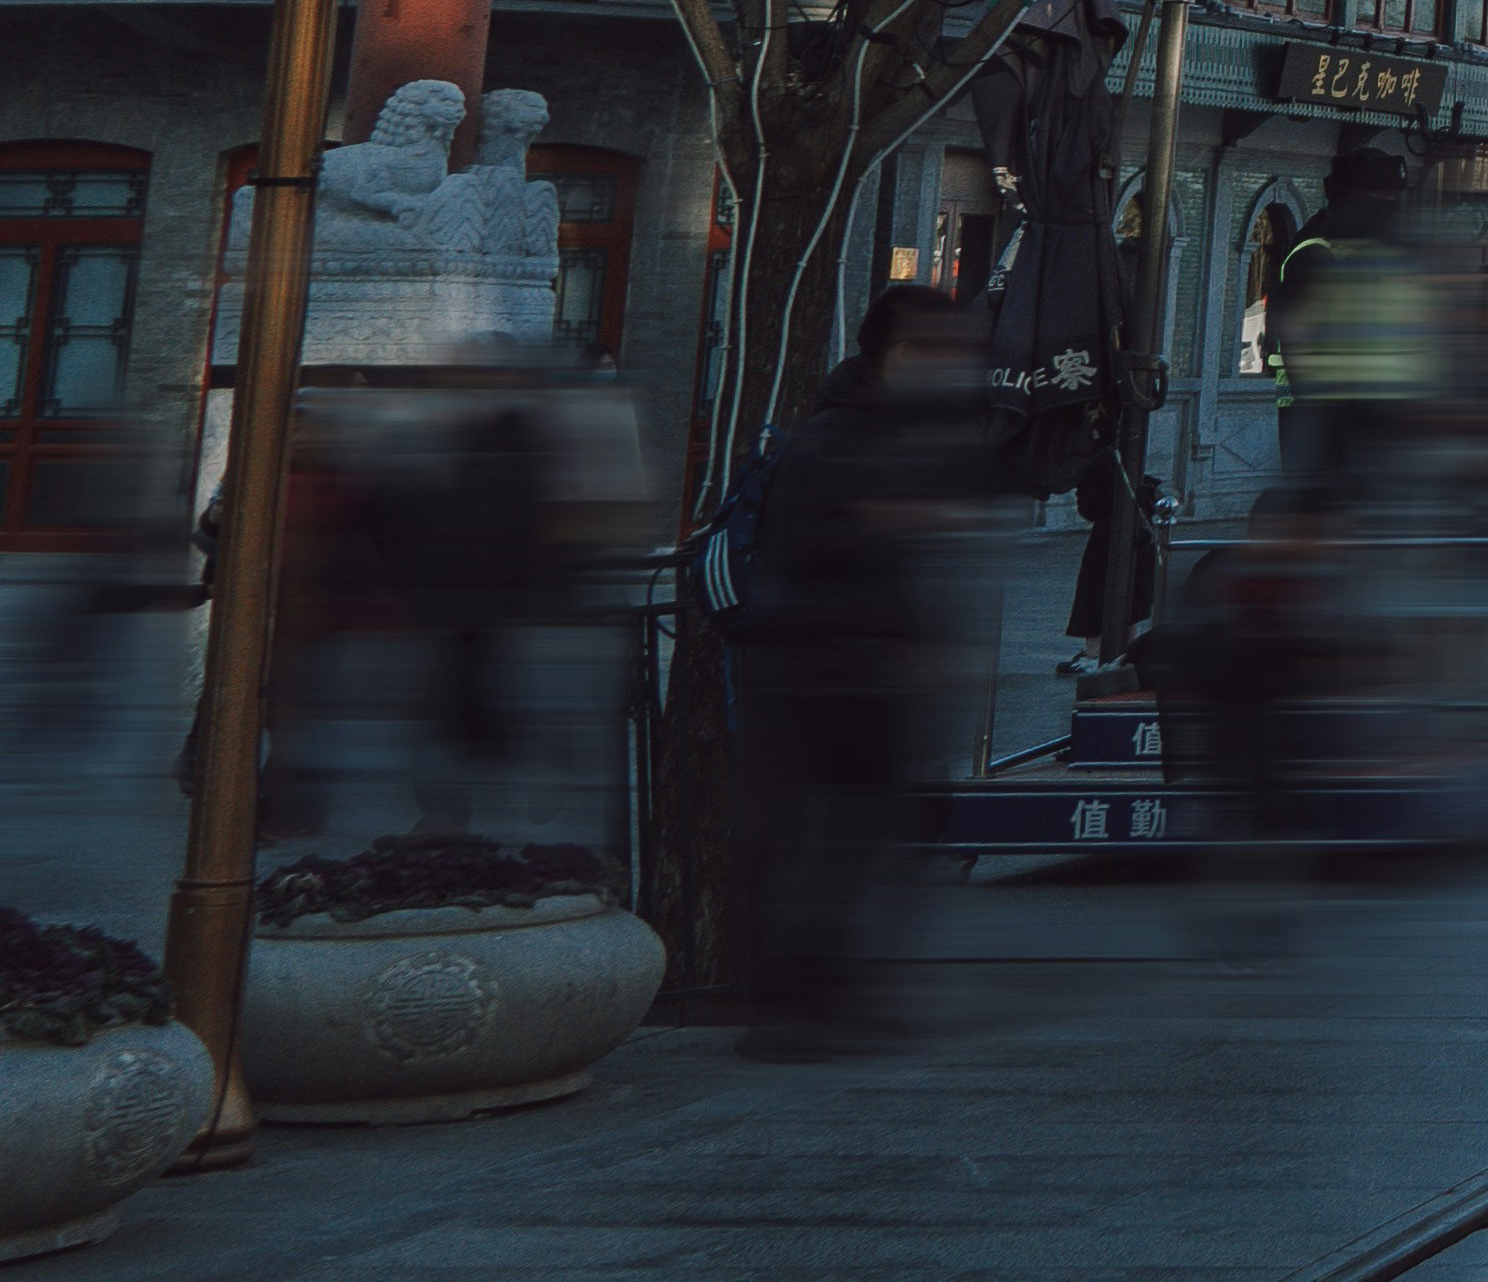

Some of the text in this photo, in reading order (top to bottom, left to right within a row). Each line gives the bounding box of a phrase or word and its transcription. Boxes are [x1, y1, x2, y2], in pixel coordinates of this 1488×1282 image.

[1311, 54, 1421, 107] 星巴克咖啡
[991, 367, 1049, 396] OLICE
[1069, 799, 1167, 840] 值勤
